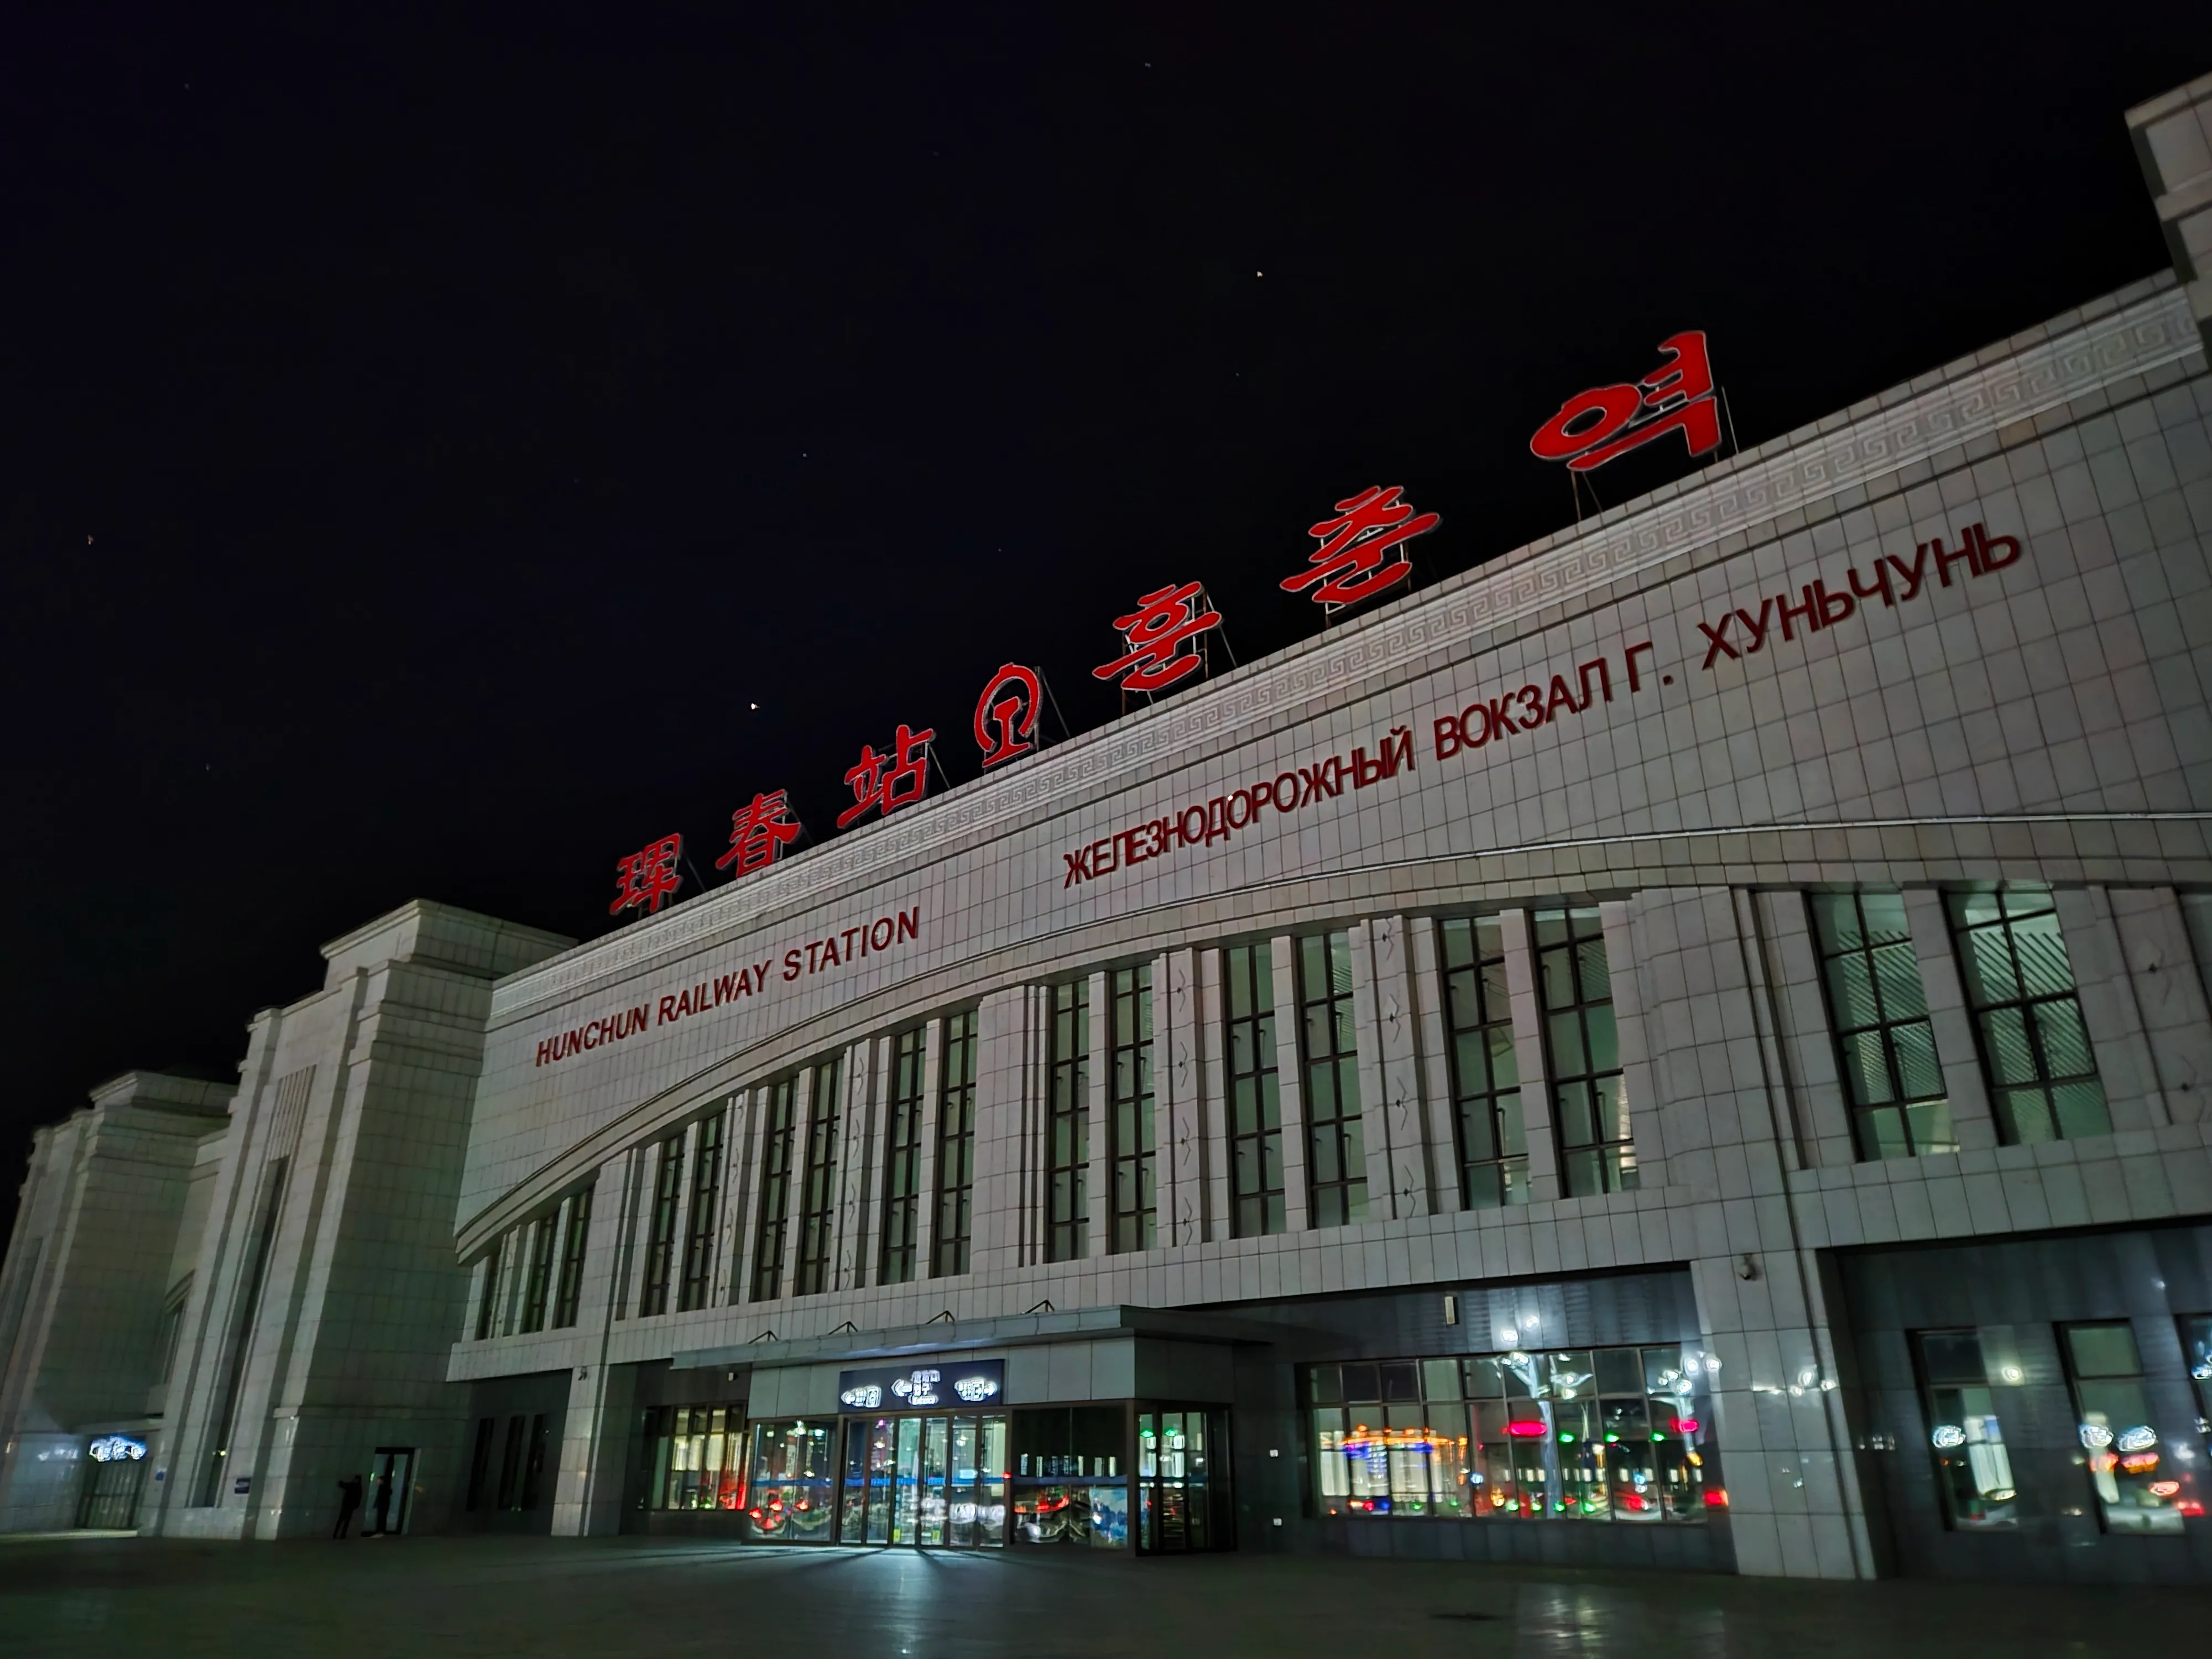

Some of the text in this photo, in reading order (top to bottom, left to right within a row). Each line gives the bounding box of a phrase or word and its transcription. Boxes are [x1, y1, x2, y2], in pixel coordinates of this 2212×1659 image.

[1092, 330, 1721, 691] 훈춘역
[609, 724, 935, 916] 珲春站
[1063, 725, 1415, 888] ЖЕЛЕЗНОДОРОЖНЫЙ
[1433, 657, 1613, 760] ВОКЗАЛ
[1697, 523, 2021, 670] ХУНЬЧУНЬ
[536, 906, 919, 1067] HUNCHUN RAILWAY STATION
